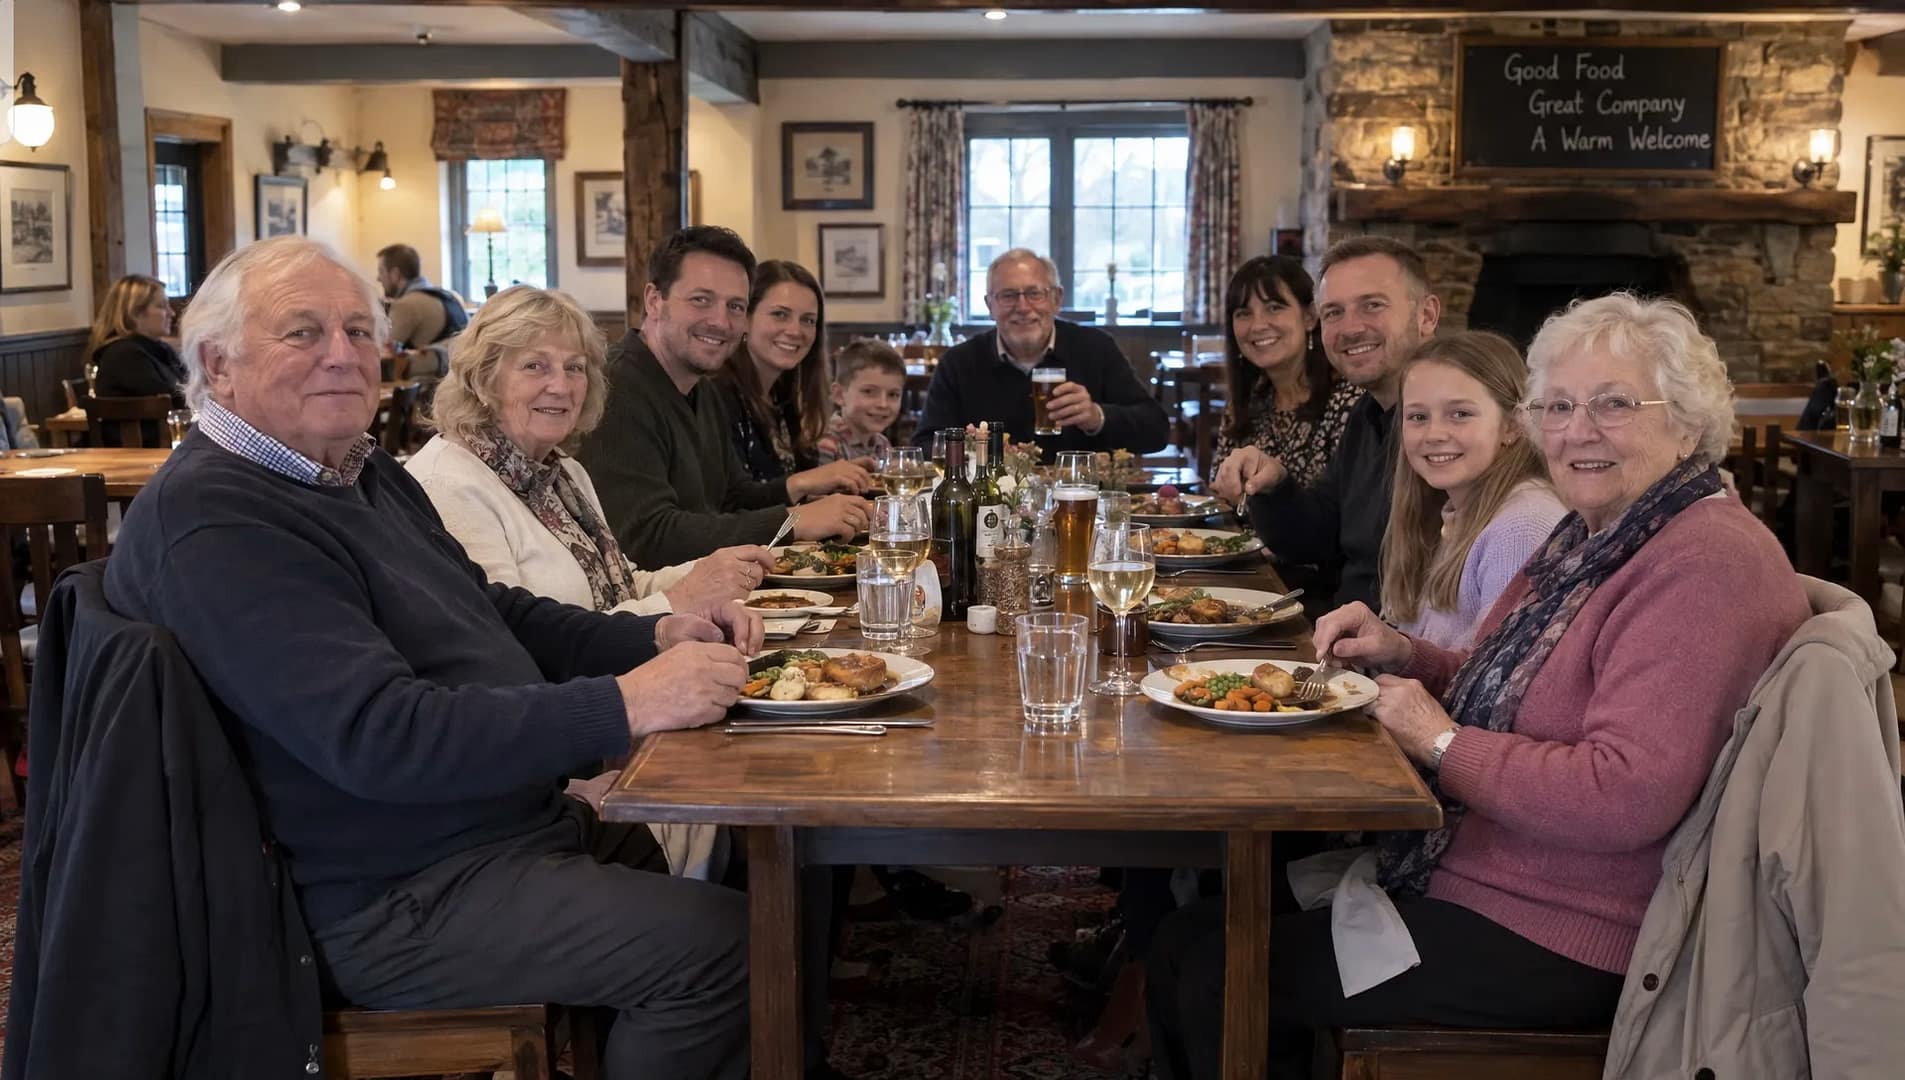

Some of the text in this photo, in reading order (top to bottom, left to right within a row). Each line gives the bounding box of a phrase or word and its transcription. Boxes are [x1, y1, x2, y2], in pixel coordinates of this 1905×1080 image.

[1504, 53, 1625, 85] Good Food
[1528, 89, 1685, 122] Great Company
[1530, 126, 1712, 151] A Warm Welcome
